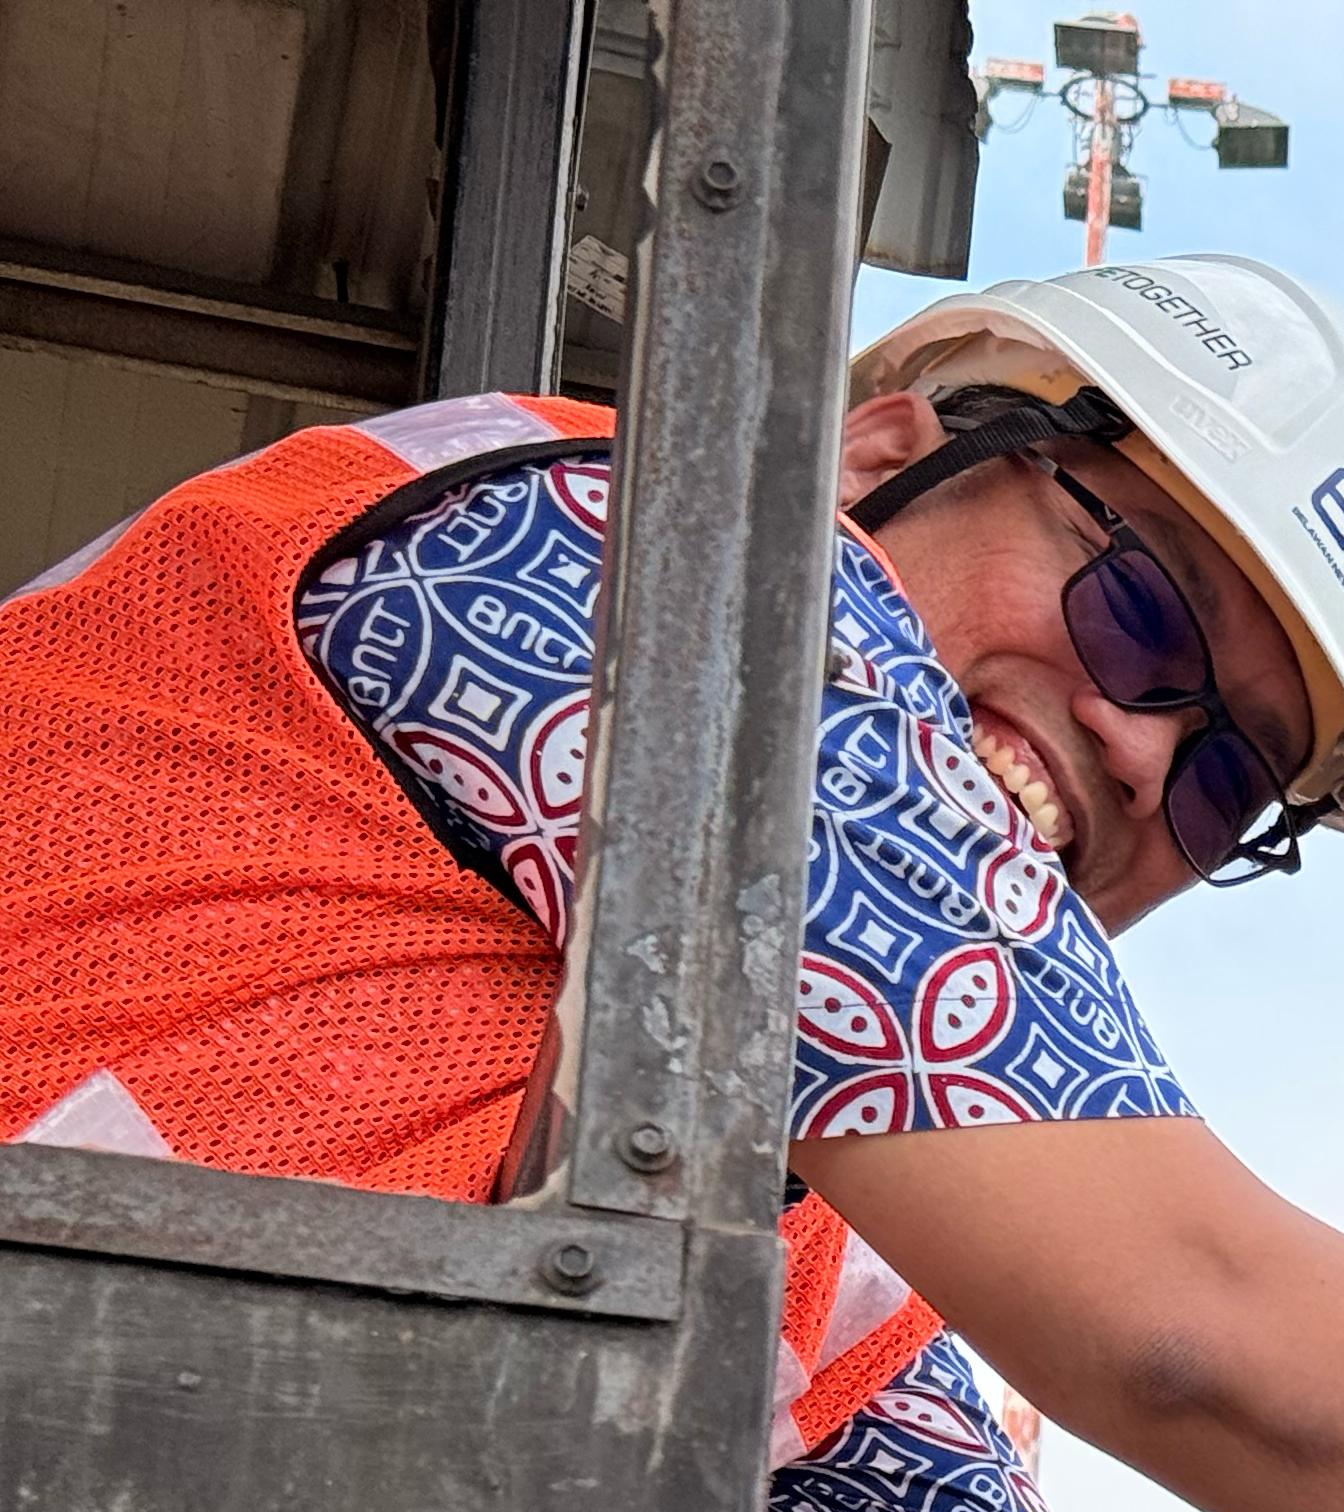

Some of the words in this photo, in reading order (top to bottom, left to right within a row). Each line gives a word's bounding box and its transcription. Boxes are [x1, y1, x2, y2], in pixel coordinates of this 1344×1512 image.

[348, 596, 411, 708] BNCT
[467, 594, 592, 669] BNCT
[855, 833, 980, 926] BNCT
[1023, 958, 1121, 1049] BNCT
